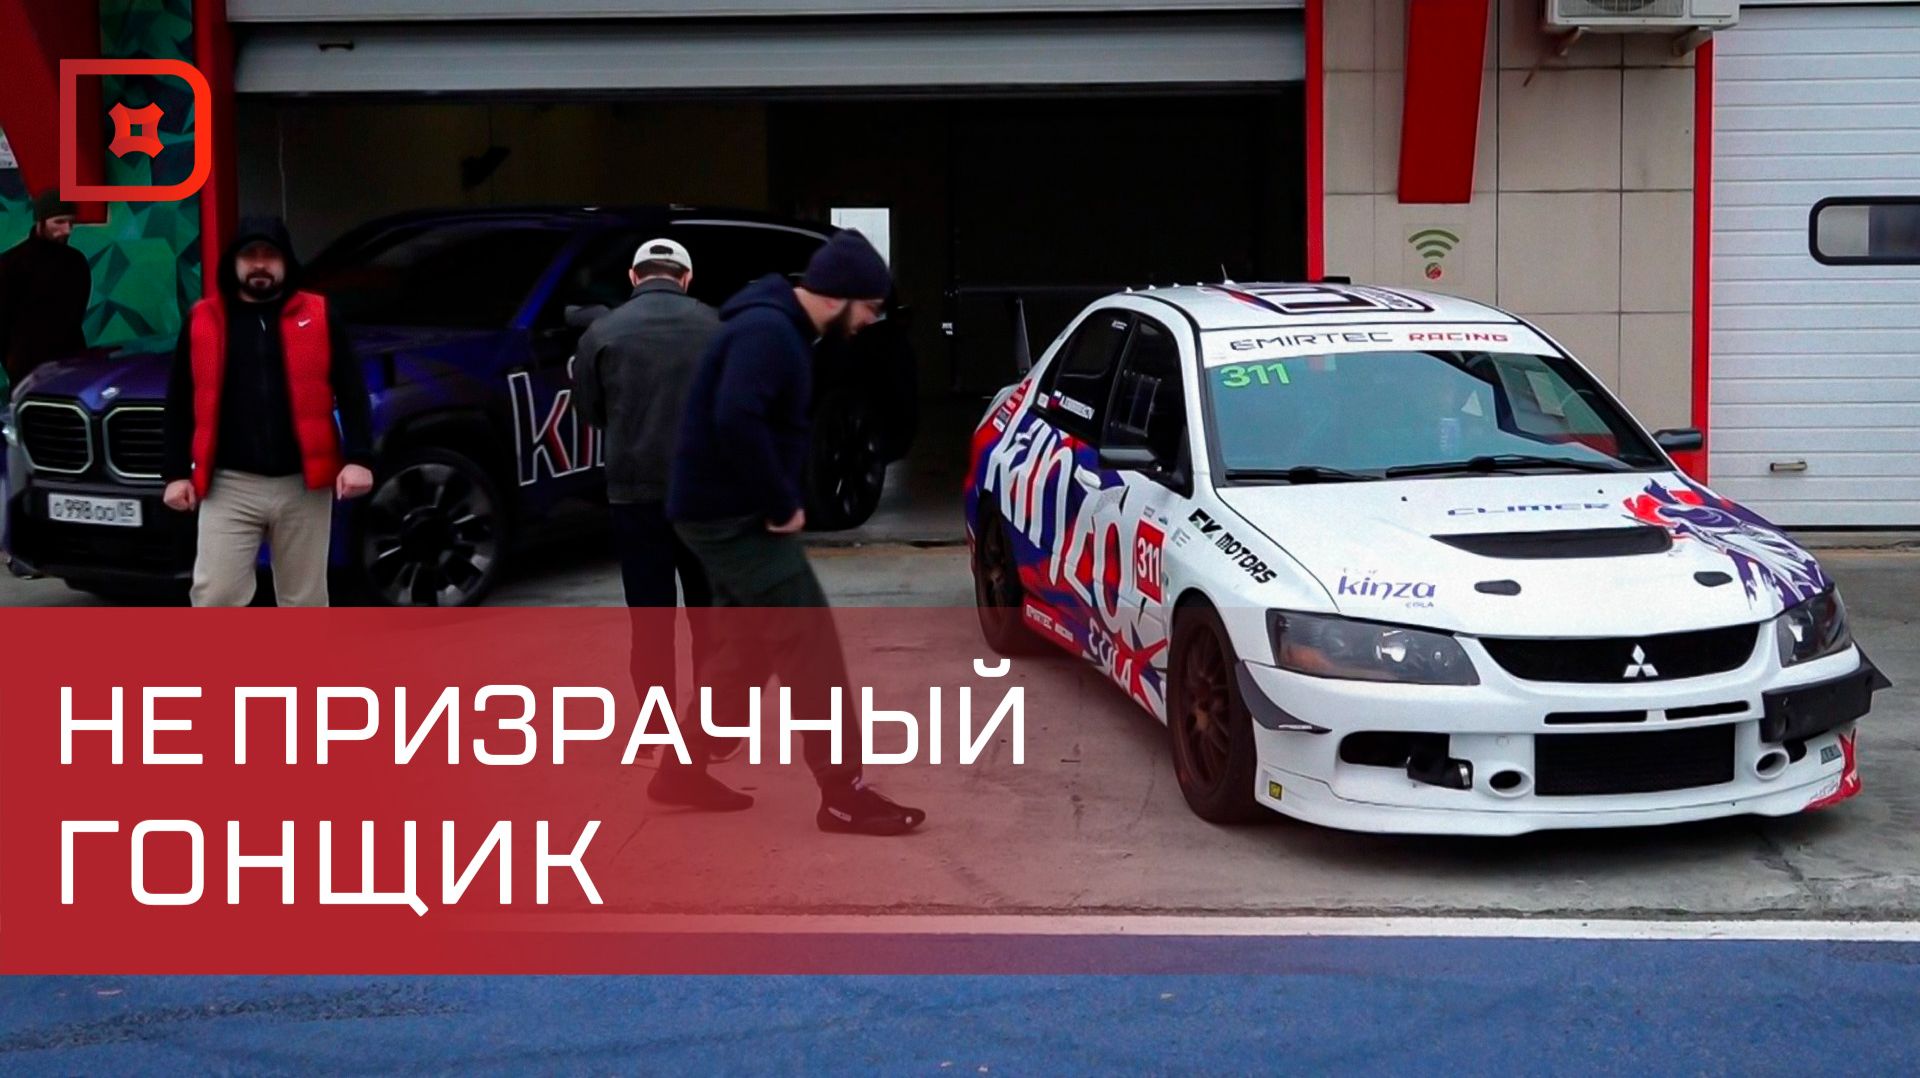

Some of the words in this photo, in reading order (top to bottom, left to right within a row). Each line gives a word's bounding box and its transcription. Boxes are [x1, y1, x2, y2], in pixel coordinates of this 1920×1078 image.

[1229, 332, 1393, 351] EMIRTEC
[1408, 331, 1509, 344] RACING
[1219, 361, 1291, 388] 311
[507, 354, 605, 486] ki
[1137, 536, 1160, 588] 311
[1338, 575, 1436, 600] kinza
